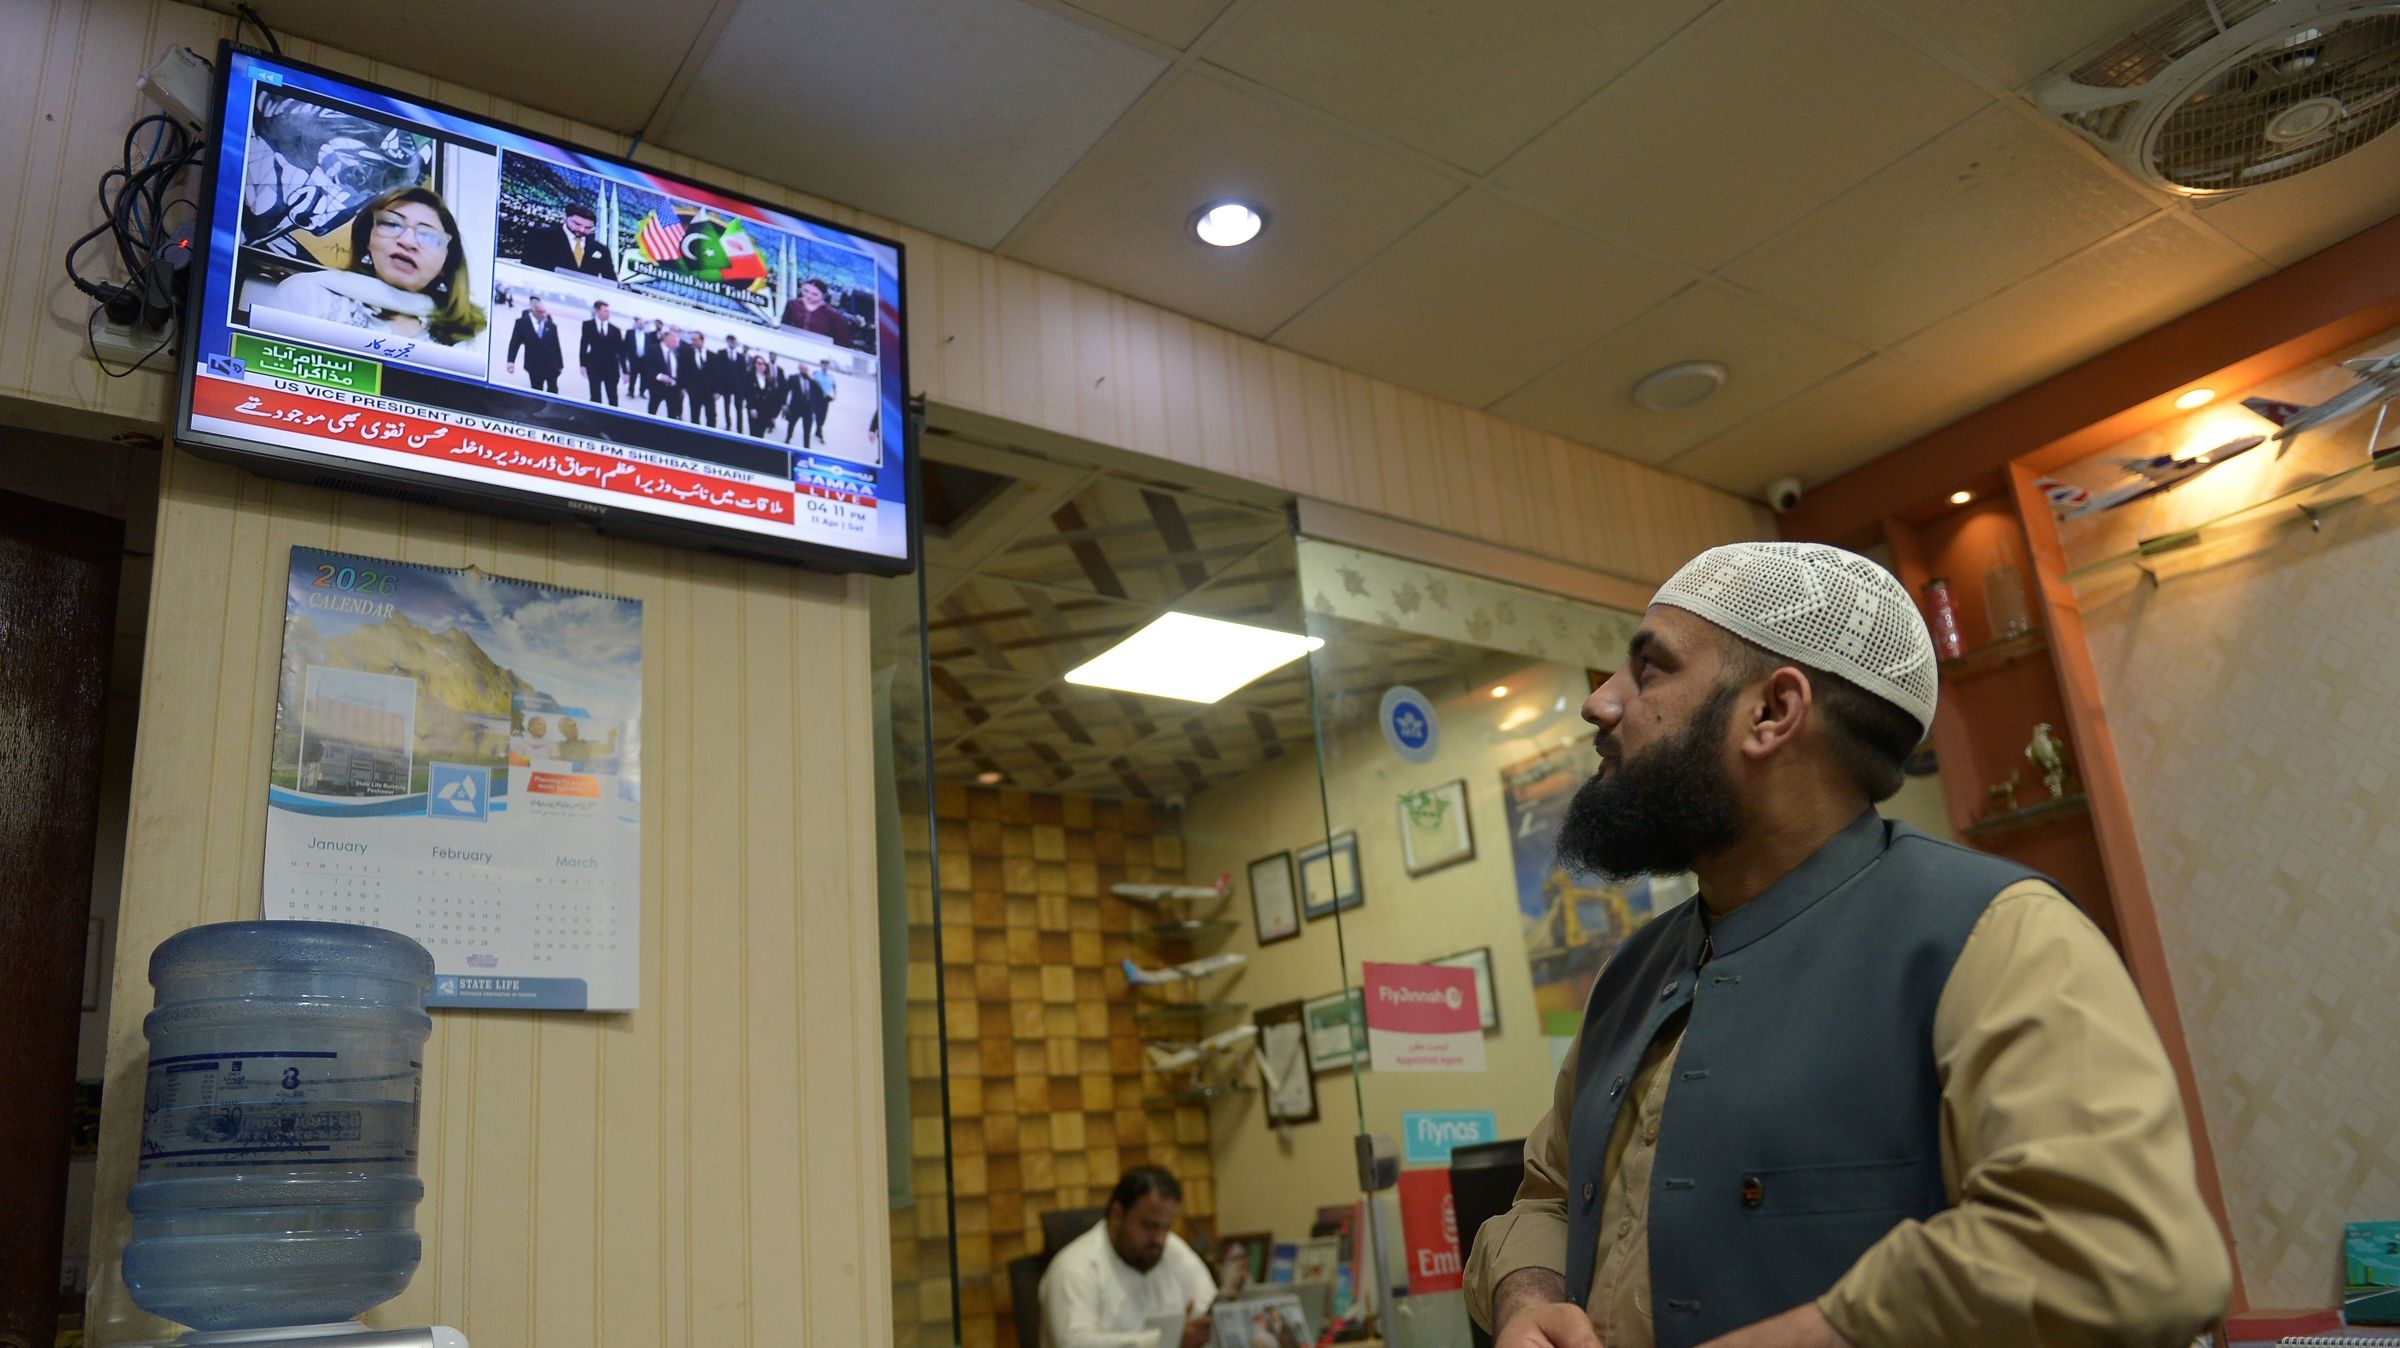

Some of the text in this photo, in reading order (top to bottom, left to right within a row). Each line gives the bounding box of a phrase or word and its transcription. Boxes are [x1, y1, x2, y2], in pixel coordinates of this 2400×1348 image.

[633, 261, 721, 293] Islamabad
[364, 338, 385, 350] کار
[261, 346, 353, 373] اسلام آباد
[259, 360, 353, 386] مذاکرات
[271, 409, 327, 425] موجود
[327, 411, 362, 434] بھی
[274, 379, 754, 482] US VICE PRESIDENT JD VANCE MEETS PM SHEHBAZ SHARIF
[360, 421, 406, 440] نقوی
[406, 426, 449, 449] محسن
[556, 455, 601, 478] اسحاق
[797, 473, 874, 496] SAMAA
[709, 489, 736, 505] میں
[809, 486, 861, 505] LIVE
[567, 500, 608, 514] SONY
[735, 497, 784, 515] ملاقات
[807, 500, 827, 513] 04
[834, 504, 845, 517] 11
[311, 563, 399, 597] 2026
[308, 591, 396, 620] CALENDAR
[307, 837, 368, 856] January
[431, 846, 492, 864] February
[555, 855, 599, 869] March
[459, 978, 520, 991] STATE LIFE
